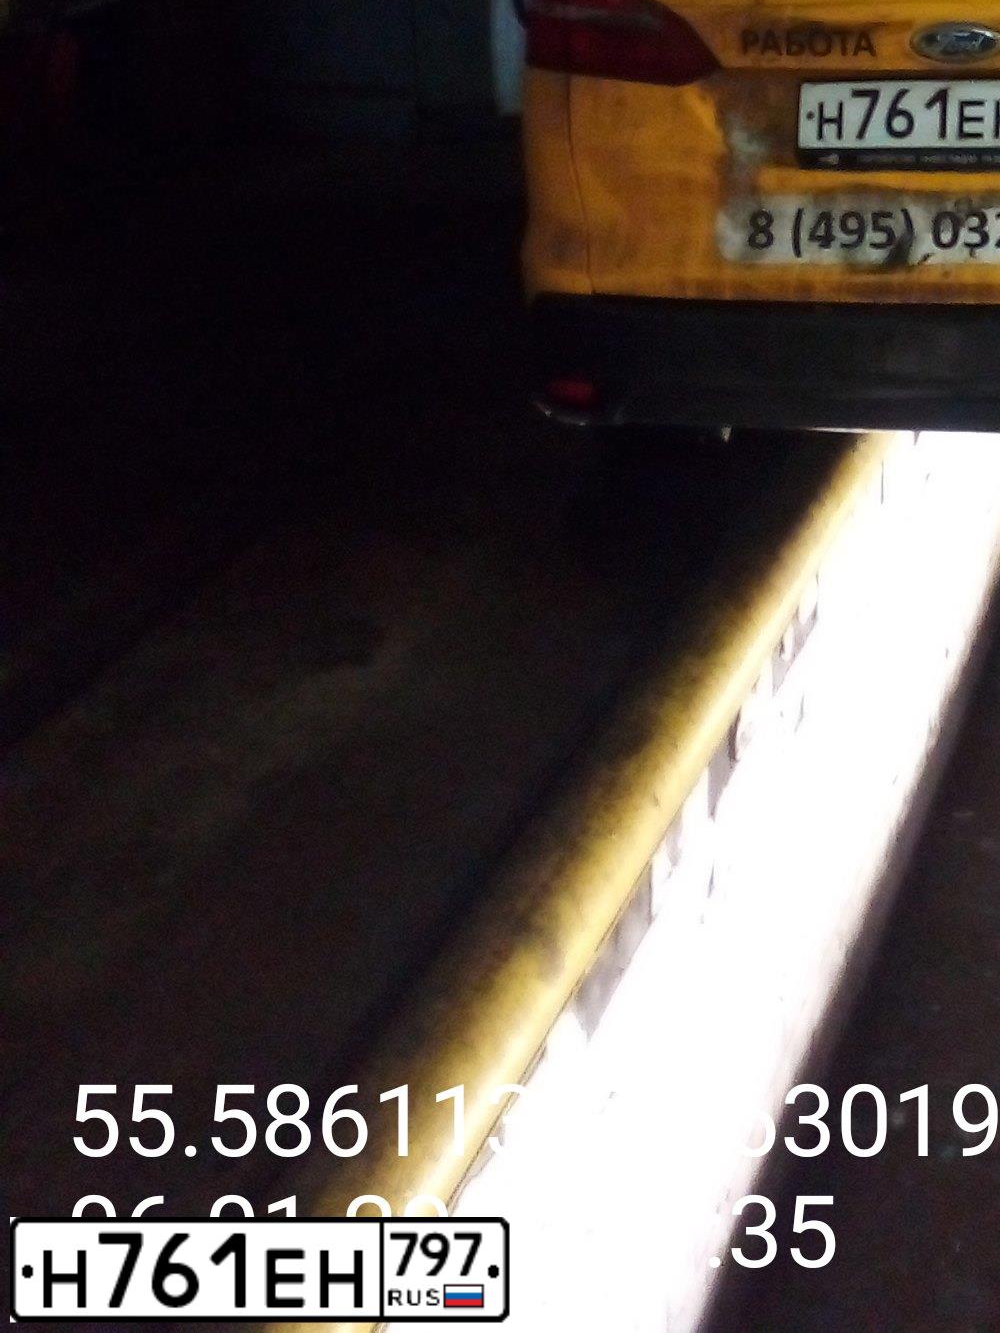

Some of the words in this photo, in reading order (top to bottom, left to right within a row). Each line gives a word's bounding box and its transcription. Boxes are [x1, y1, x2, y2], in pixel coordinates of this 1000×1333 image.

[740, 28, 877, 58] РАБОТА
[748, 209, 774, 249] 8
[791, 207, 915, 258] (495)
